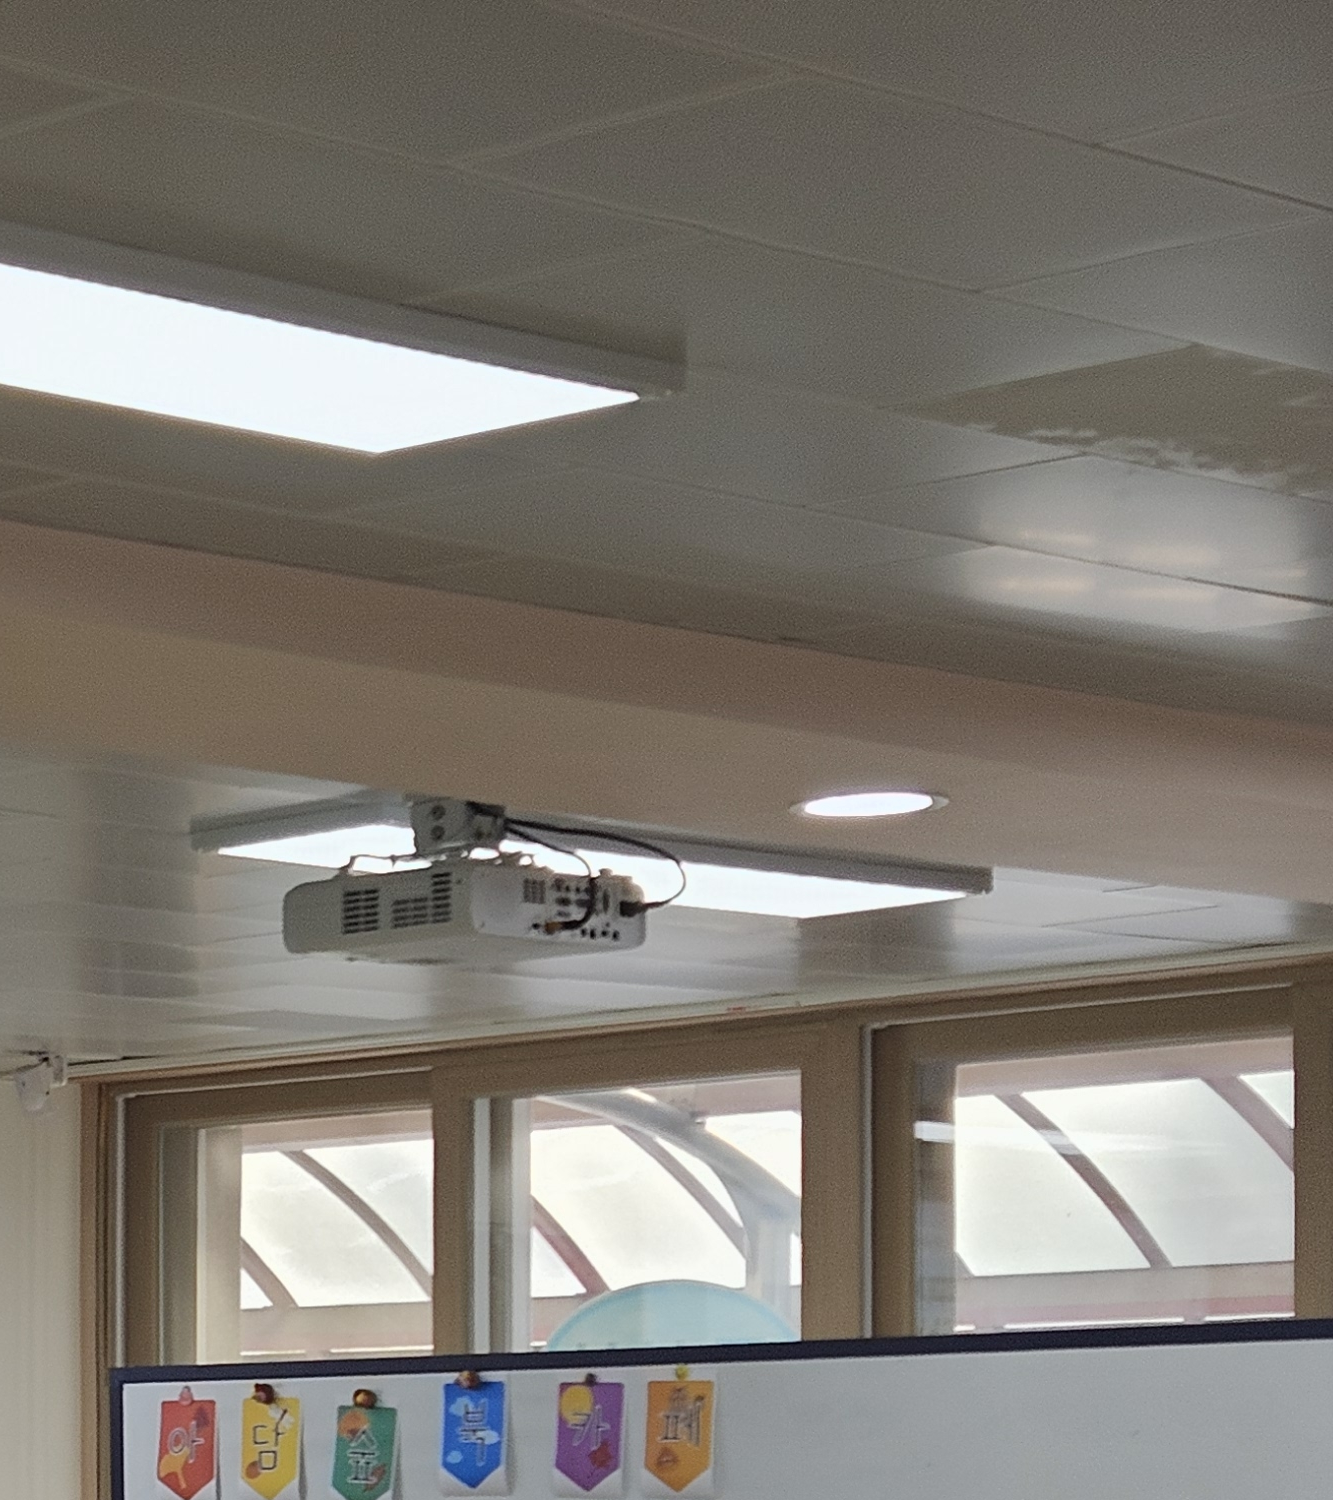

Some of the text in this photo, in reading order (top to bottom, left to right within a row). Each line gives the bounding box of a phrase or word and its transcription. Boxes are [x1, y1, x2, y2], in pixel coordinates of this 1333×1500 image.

[167, 1396, 702, 1485] 아 담 숲 북 카 페
